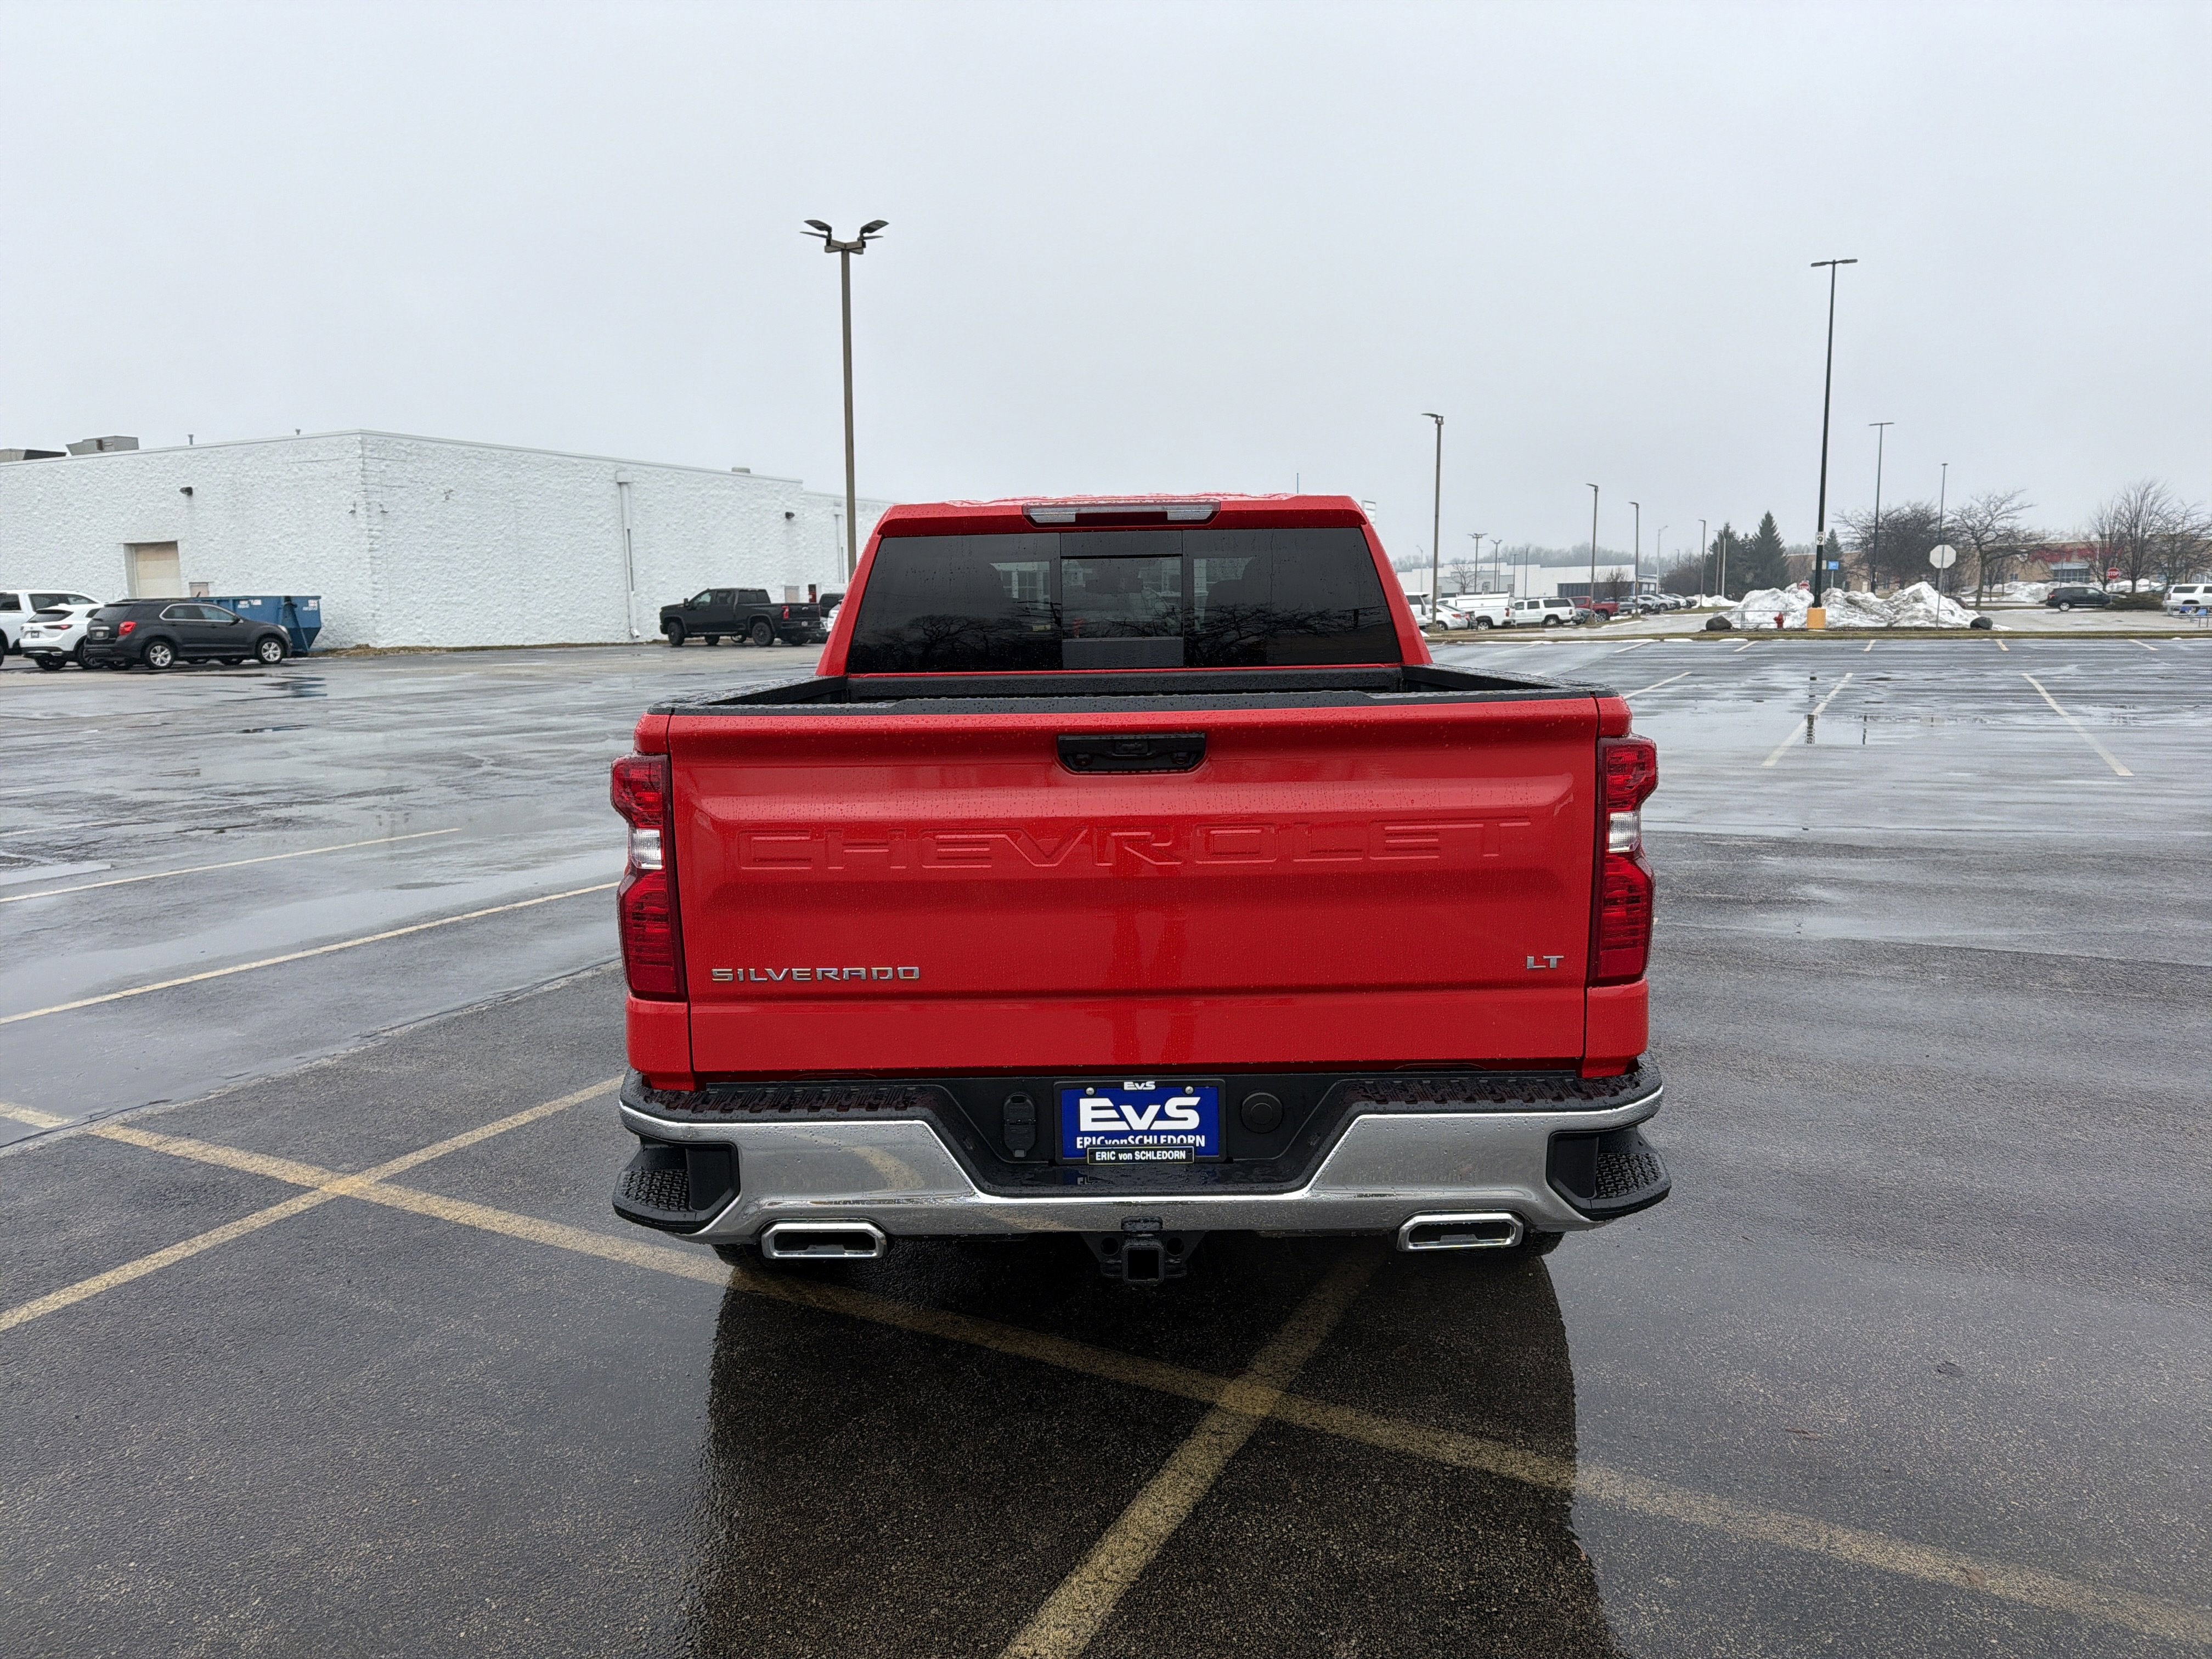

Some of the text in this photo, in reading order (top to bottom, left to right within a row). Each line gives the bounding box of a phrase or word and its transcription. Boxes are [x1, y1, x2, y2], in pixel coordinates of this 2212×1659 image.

[1817, 536, 1824, 544] 9
[739, 817, 1531, 870] CHEVROLET
[1526, 955, 1565, 970] LT
[711, 966, 921, 982] SILVERADO
[1096, 1150, 1186, 1161] ERIC von SCHLEDORN
